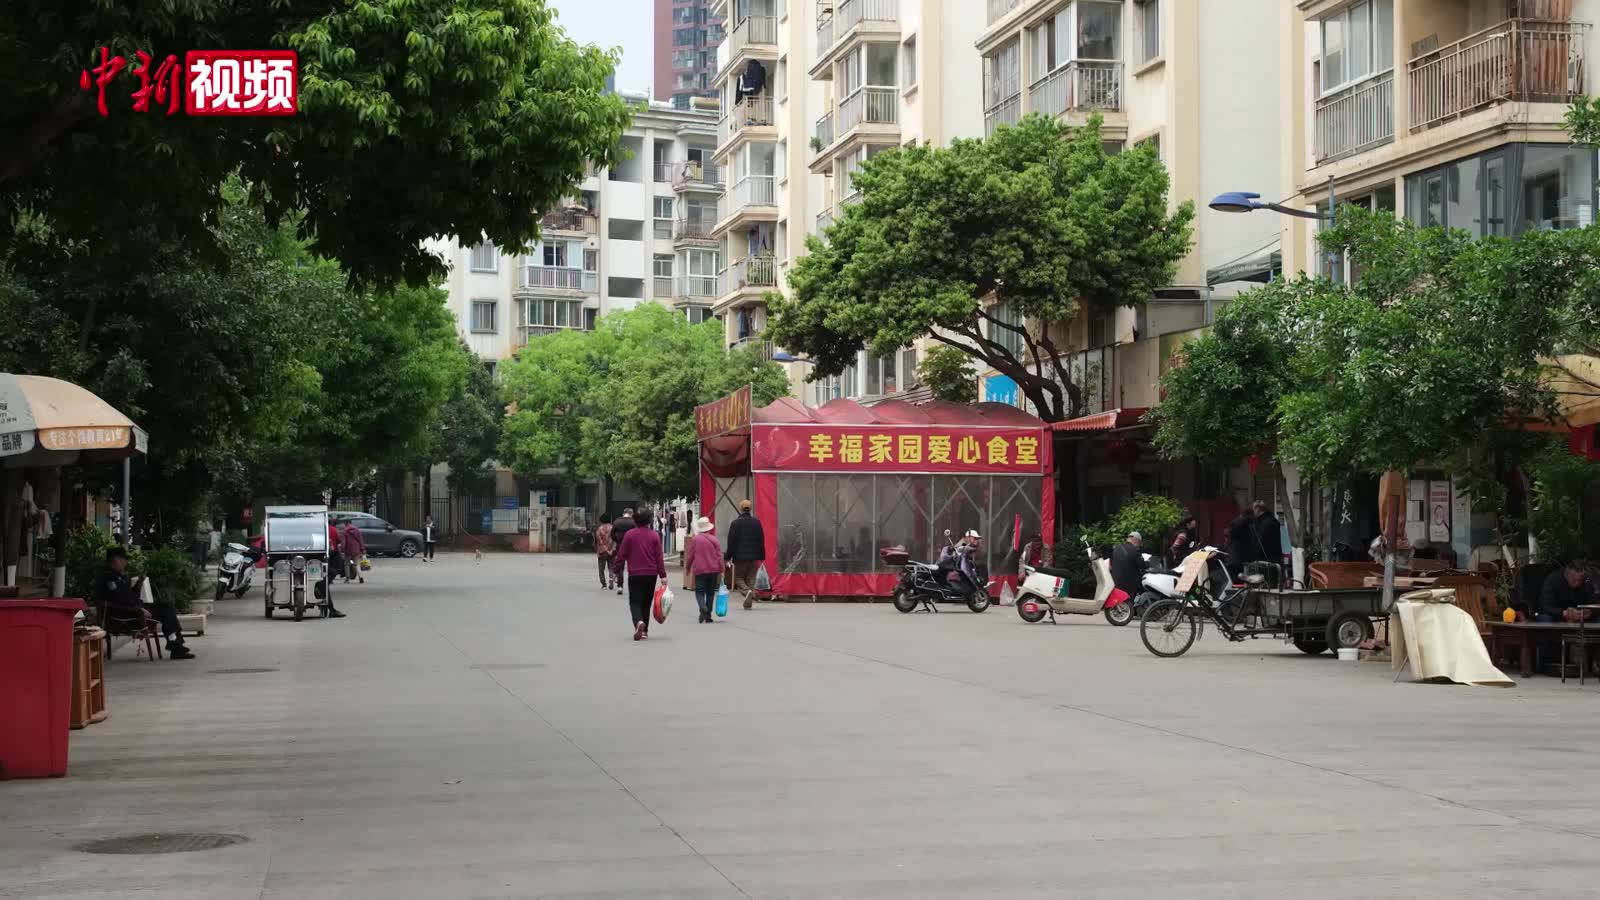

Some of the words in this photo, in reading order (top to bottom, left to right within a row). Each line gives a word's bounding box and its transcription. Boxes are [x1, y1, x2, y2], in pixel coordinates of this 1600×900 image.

[808, 434, 1039, 465] 幸福家园爱心食堂
